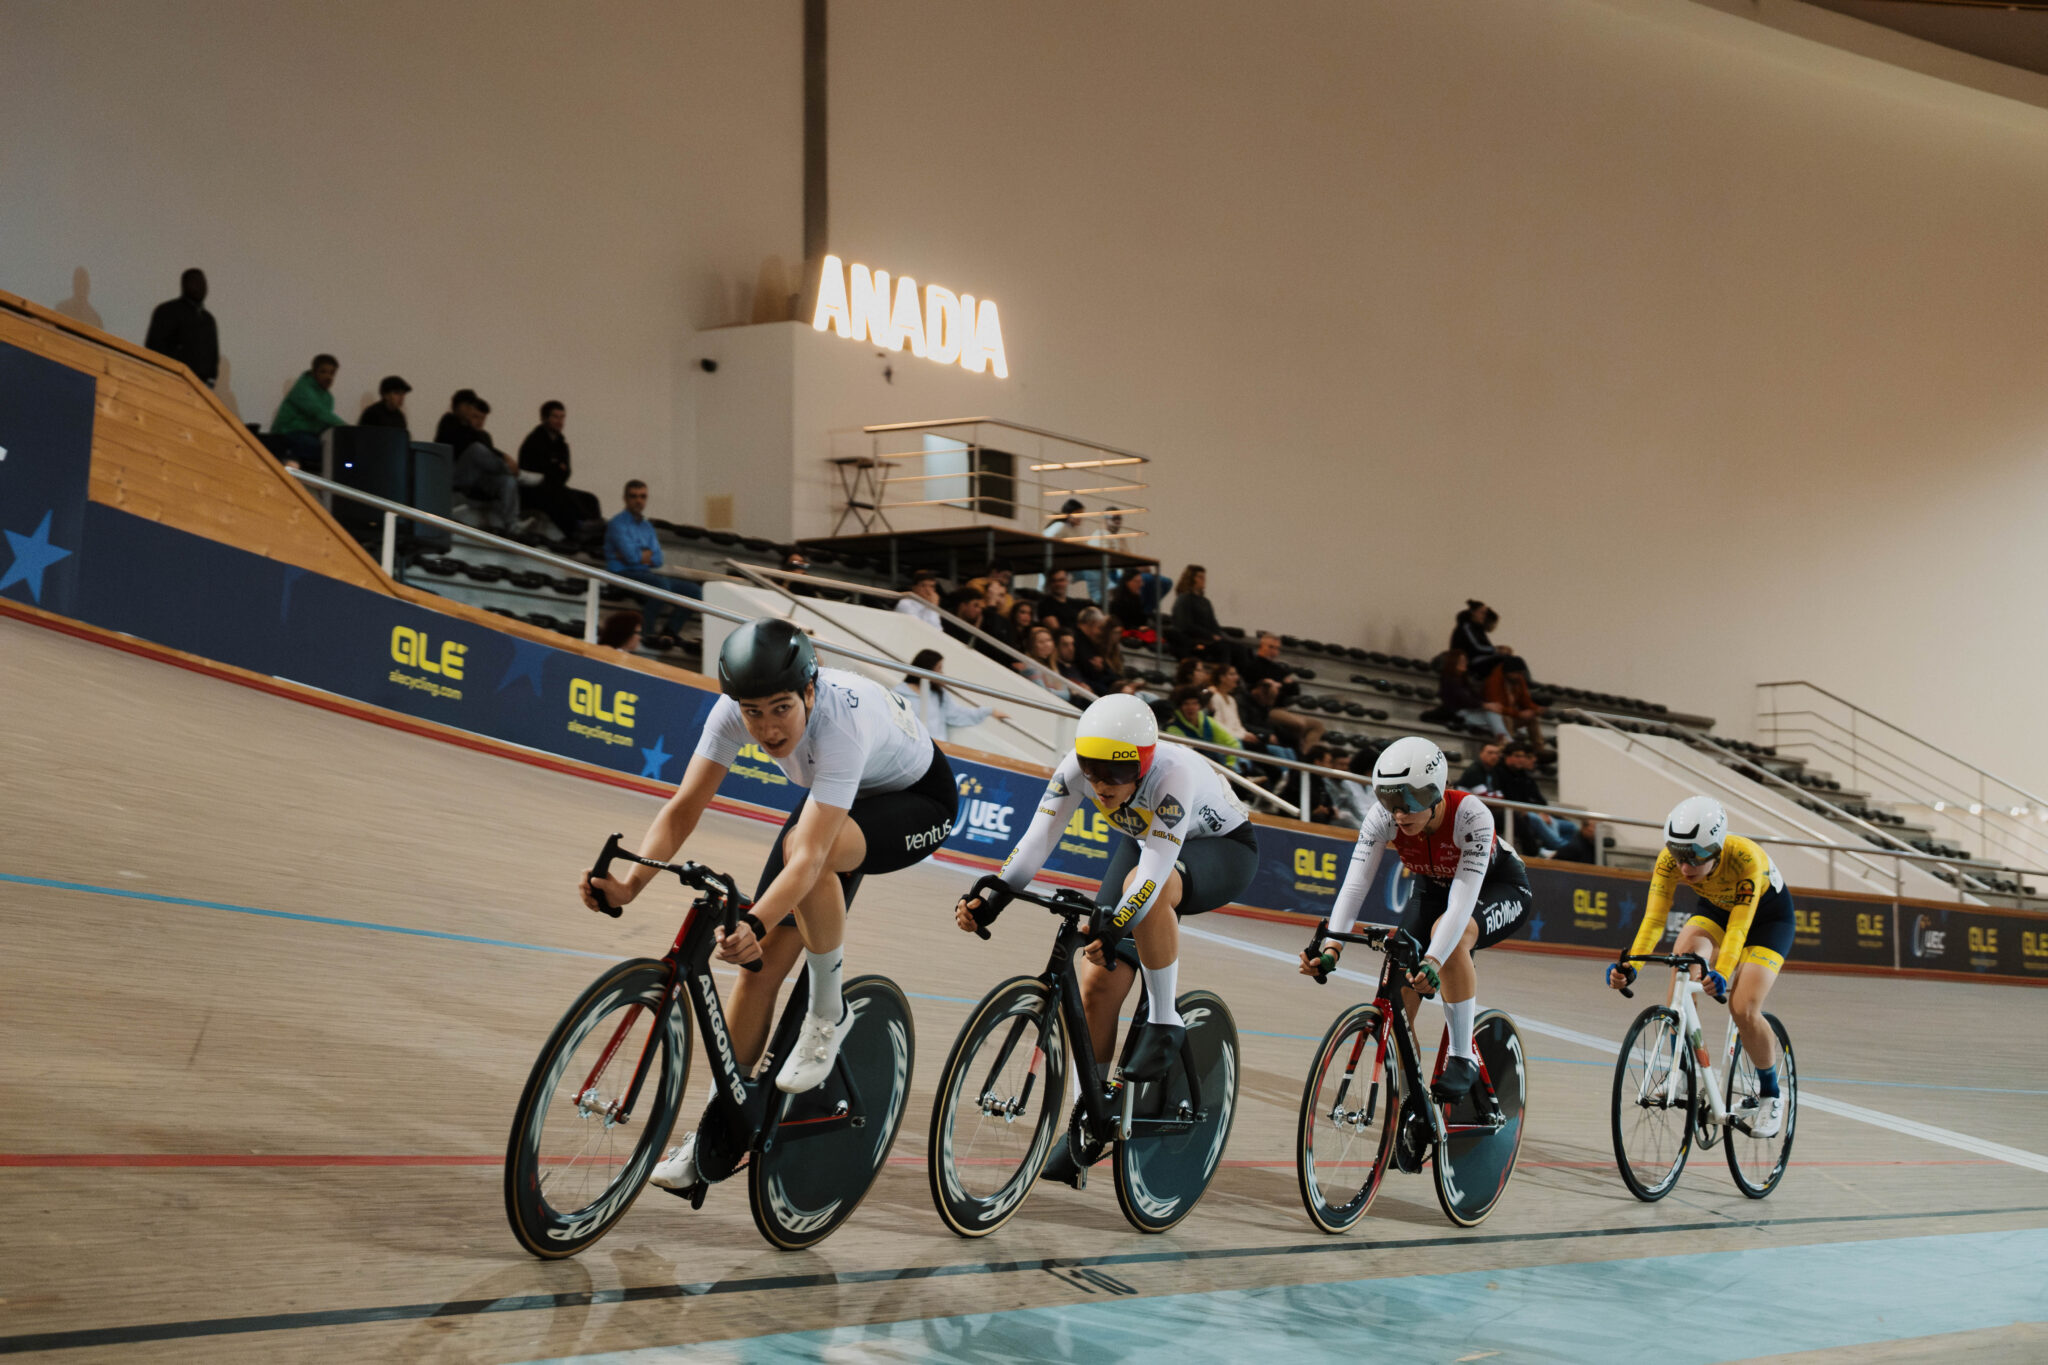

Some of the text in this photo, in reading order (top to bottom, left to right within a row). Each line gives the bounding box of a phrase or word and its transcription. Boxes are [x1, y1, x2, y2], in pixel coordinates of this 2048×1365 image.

[812, 254, 1009, 379] ANADIA
[904, 818, 952, 852] ventus
[968, 799, 1015, 834] UEC
[1112, 879, 1157, 928] OdL Team
[698, 974, 748, 1107] ARGON 18
